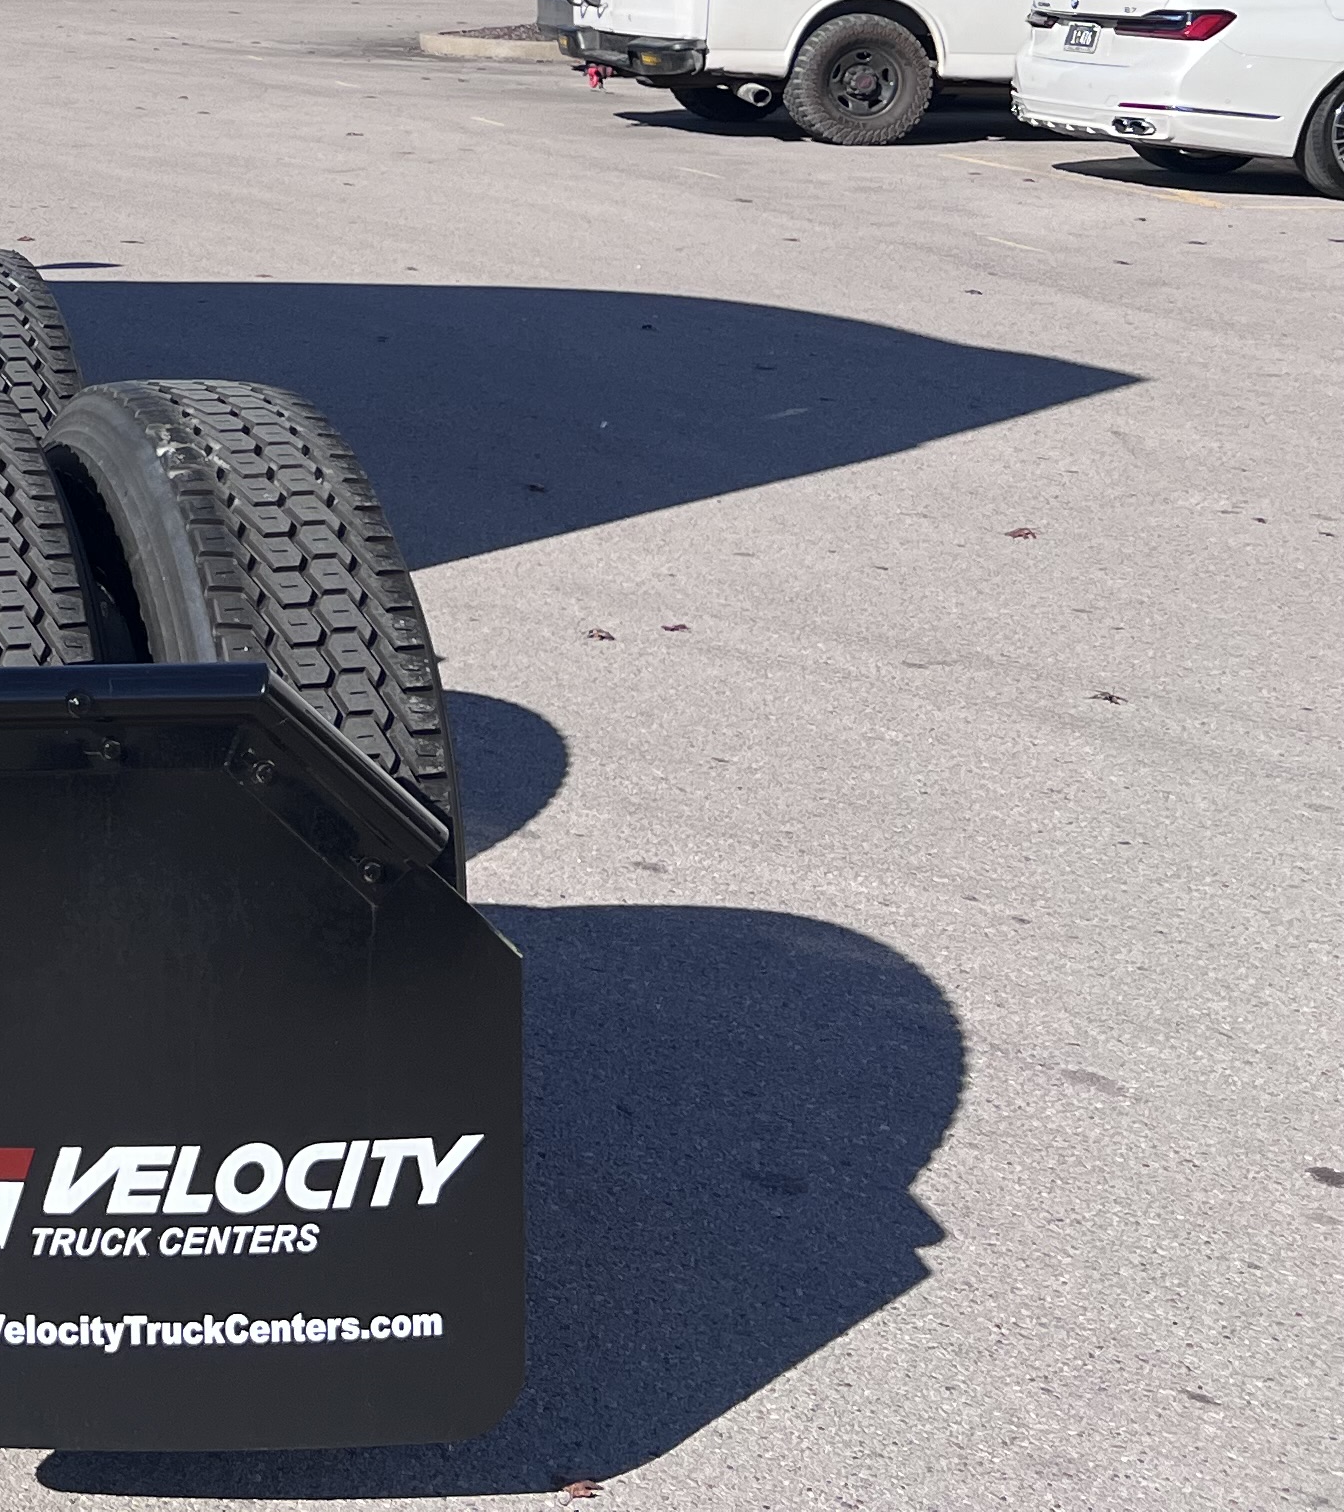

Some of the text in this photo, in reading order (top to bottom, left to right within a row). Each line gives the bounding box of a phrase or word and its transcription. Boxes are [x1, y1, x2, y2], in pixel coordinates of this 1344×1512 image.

[42, 1132, 485, 1216] VELOCITY
[31, 1222, 321, 1258] TRUCK CENTERS
